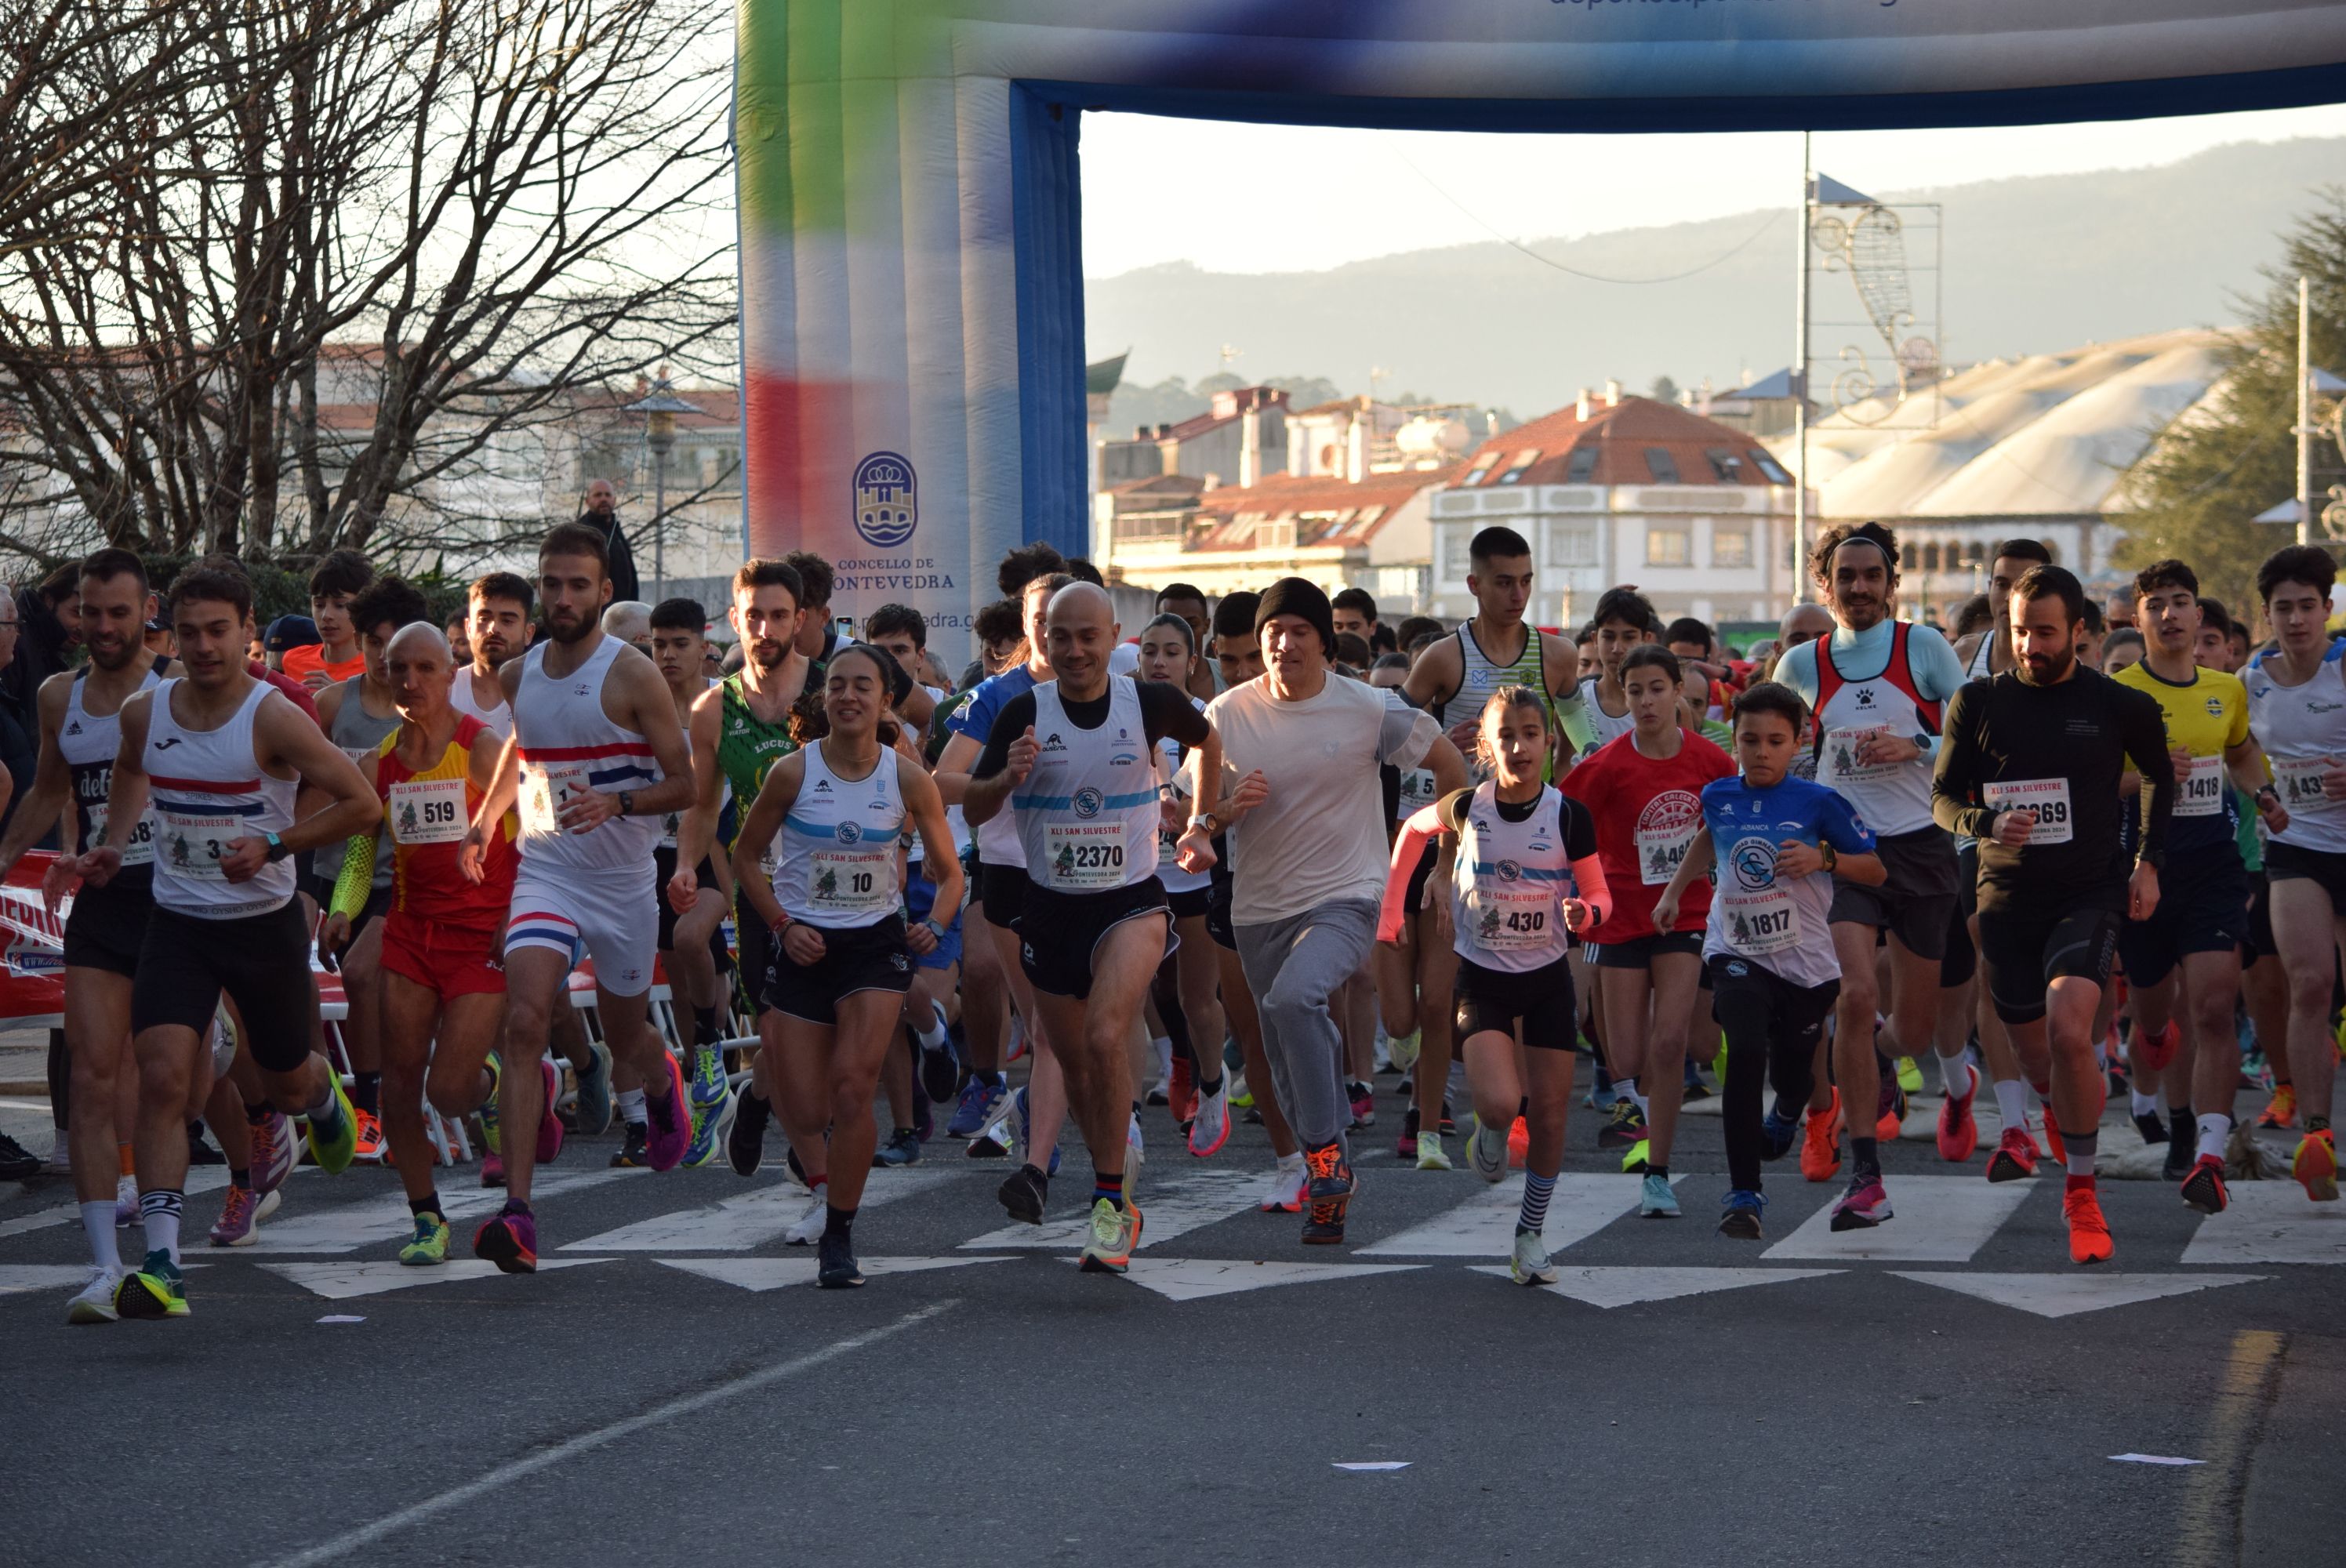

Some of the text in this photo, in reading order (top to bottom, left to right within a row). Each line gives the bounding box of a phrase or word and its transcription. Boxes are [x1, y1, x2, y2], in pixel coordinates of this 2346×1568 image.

[837, 557, 935, 571] CONCELLO DE
[832, 574, 955, 590] ONTEVEDRA
[728, 728, 750, 736] VIATOR
[754, 739, 792, 754] LUCUS
[395, 782, 459, 795] XLI SAN SILVESTRE
[1991, 782, 2062, 795] XLI SAN SILVESTRE
[2187, 776, 2219, 799] 1418
[184, 792, 212, 800] SPIKES
[424, 800, 456, 824] 519
[1641, 799, 1664, 826] CAPITAL
[194, 818, 235, 828] SILVESTRE
[1051, 826, 1121, 836] XLI SAN SILVESTRE
[815, 853, 885, 863] XLI SAN SILVESTRE
[1076, 844, 1124, 868] 2370
[852, 872, 873, 893] 10
[1493, 891, 1509, 901] SAN
[1511, 893, 1549, 902] SILVESTRE
[1749, 891, 1788, 905] SILVESTRE
[211, 905, 244, 916] OYSHO
[246, 898, 278, 911] OYSHO
[1506, 910, 1545, 932] 430
[1750, 909, 1790, 936] 1817
